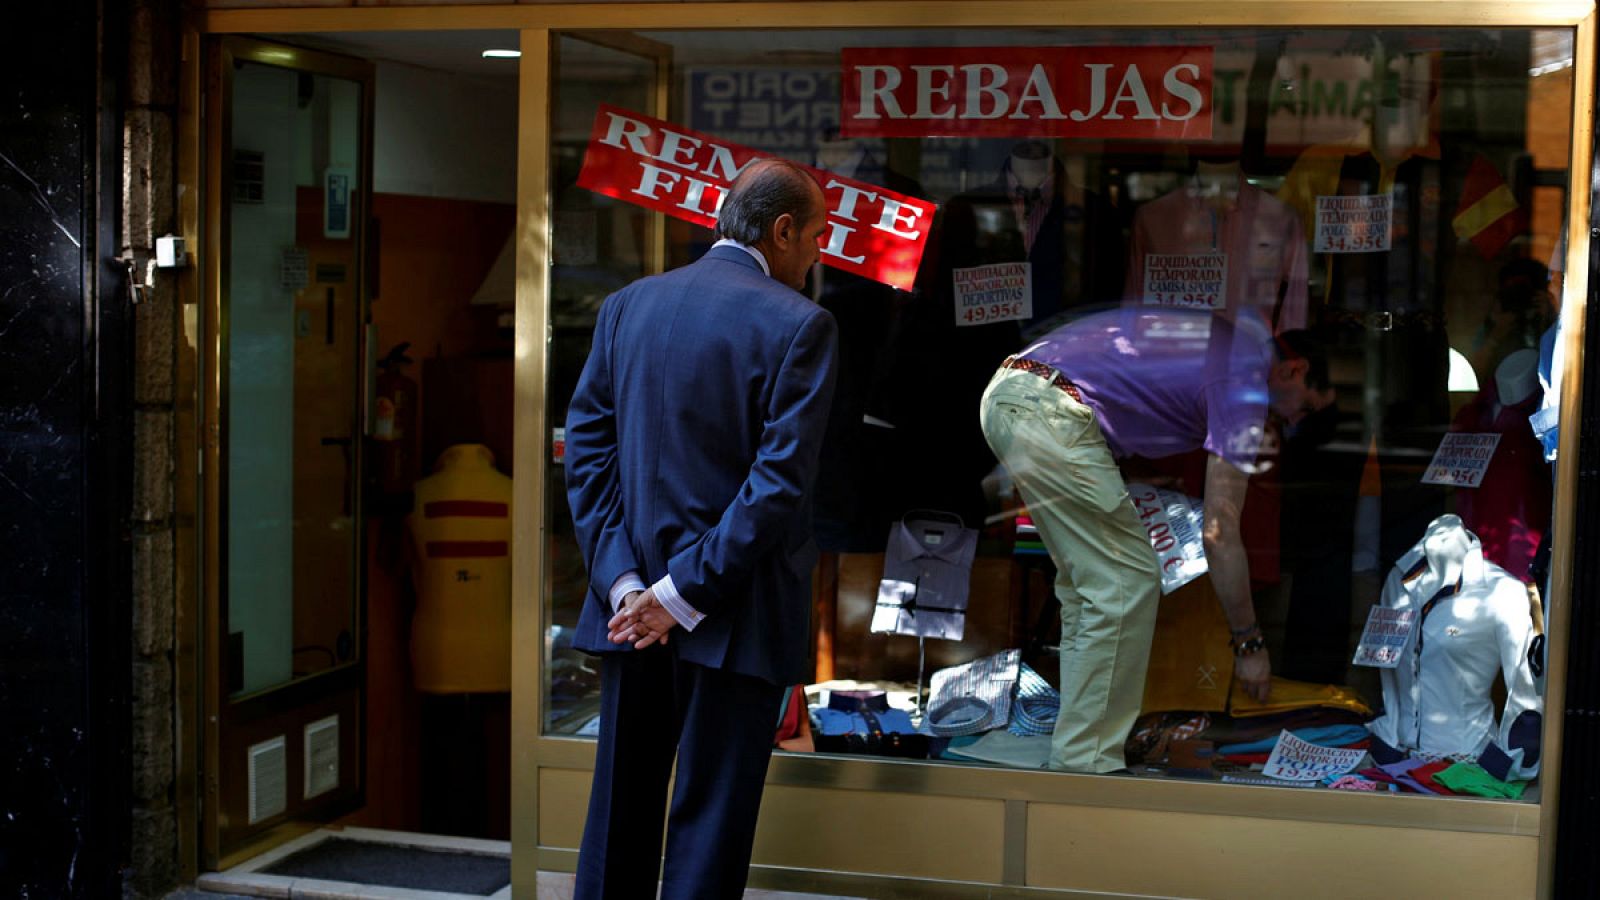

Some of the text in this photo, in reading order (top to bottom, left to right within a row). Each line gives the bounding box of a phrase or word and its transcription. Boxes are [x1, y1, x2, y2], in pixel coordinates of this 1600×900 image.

[853, 63, 1203, 122] REBAJAS
[598, 111, 924, 241] REMTE
[1319, 195, 1391, 210] LIQUIDACION
[631, 161, 866, 264] FIL
[1319, 208, 1387, 224] TEMPORADA
[1148, 255, 1225, 269] LIQUIDACION
[955, 264, 1026, 283] LIQUIDACION
[1148, 268, 1223, 281] TEMPORADA
[957, 279, 1025, 293] TEMPORADA
[1148, 281, 1222, 293] CAMISA SPORT
[963, 288, 1023, 306] DEPORTIVAS
[1281, 732, 1361, 758] LIQUIDACION
[1279, 744, 1356, 766] TEMPORADA
[1276, 756, 1351, 772] POLOS
